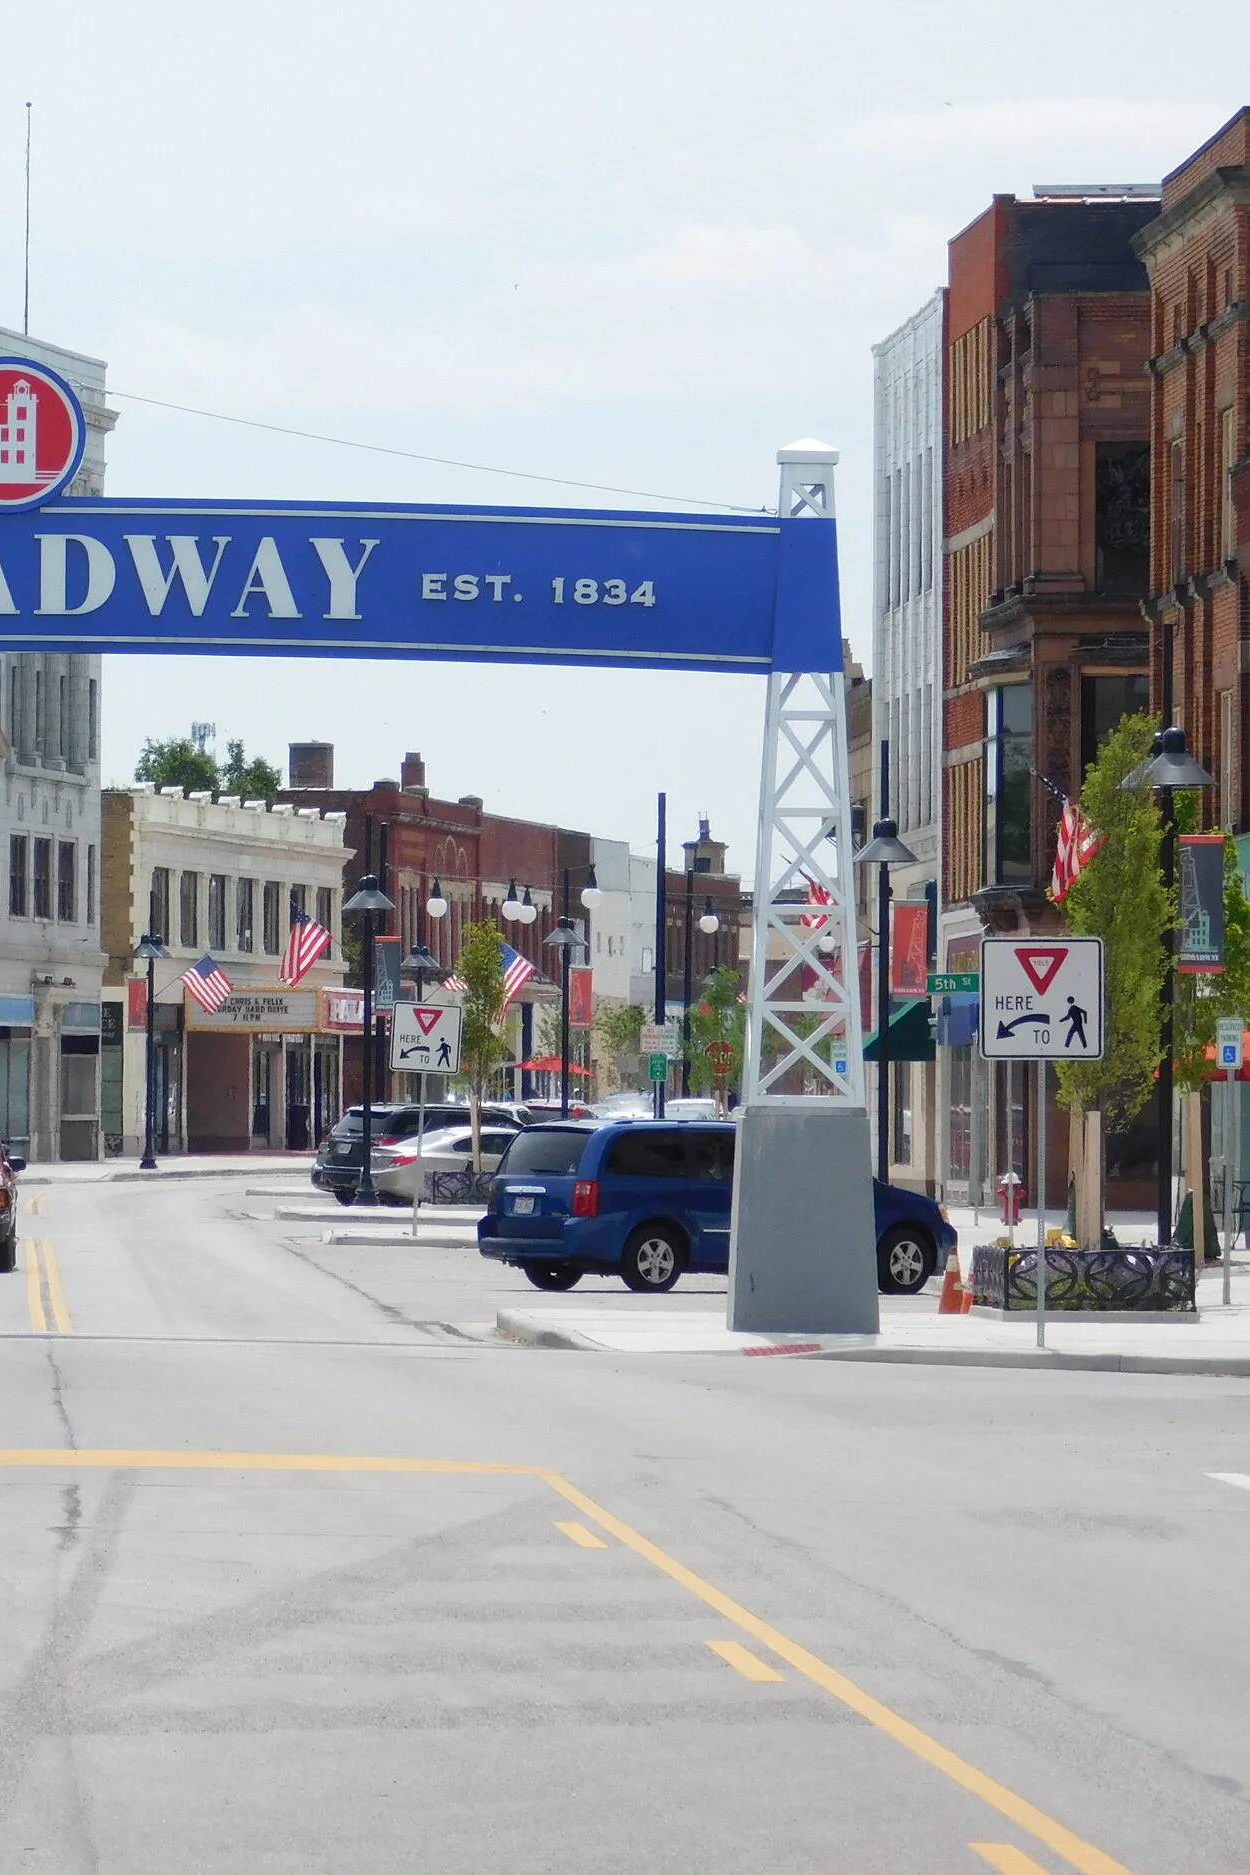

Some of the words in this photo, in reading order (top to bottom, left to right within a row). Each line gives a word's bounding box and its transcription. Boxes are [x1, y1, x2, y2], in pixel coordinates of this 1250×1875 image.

[421, 573, 523, 602] EST.
[552, 577, 656, 607] 1834
[935, 979, 957, 991] 5th
[962, 977, 972, 986] St
[262, 998, 284, 1006] FELIX
[995, 996, 1034, 1010] HERE
[399, 1034, 422, 1044] HERE
[1033, 1029, 1050, 1044] TO
[419, 1054, 430, 1064] TO
